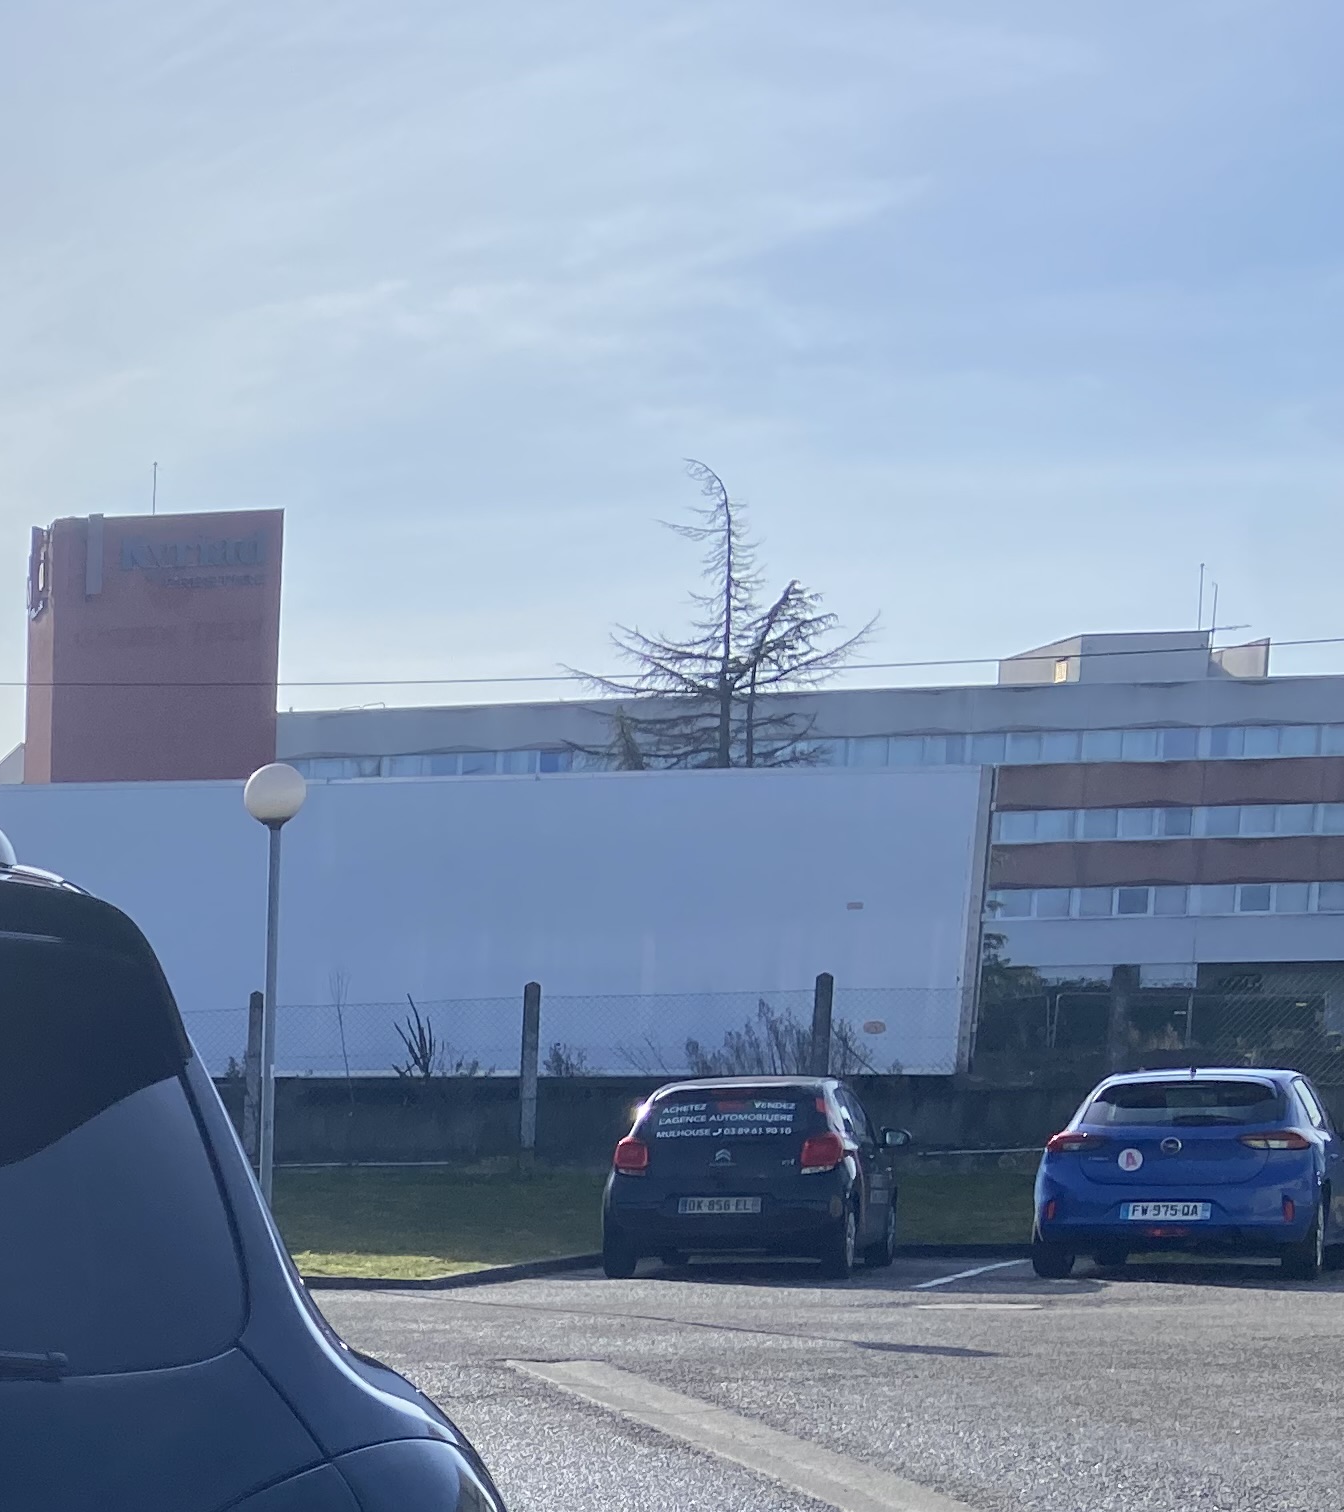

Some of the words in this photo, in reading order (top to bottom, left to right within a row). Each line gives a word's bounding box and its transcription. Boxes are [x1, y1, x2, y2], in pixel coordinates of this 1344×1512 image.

[662, 1103, 707, 1114] ACHETEZ
[754, 1101, 796, 1110] VENDEZ
[656, 1128, 711, 1138] MULHOUSE
